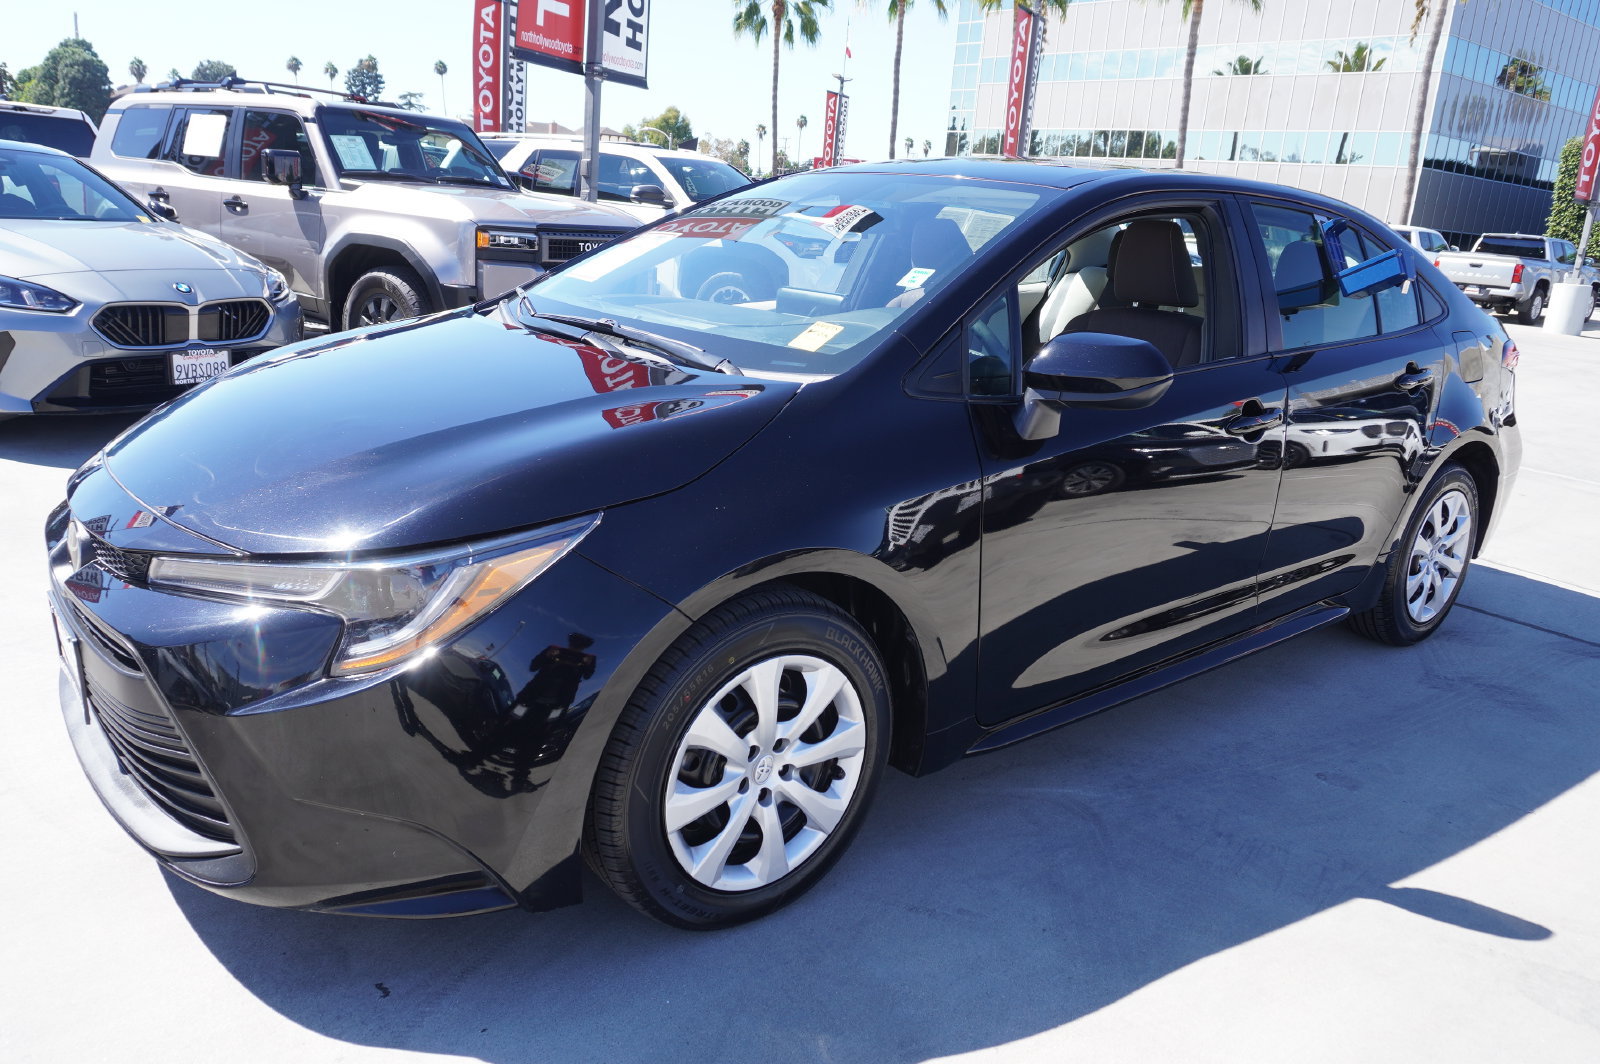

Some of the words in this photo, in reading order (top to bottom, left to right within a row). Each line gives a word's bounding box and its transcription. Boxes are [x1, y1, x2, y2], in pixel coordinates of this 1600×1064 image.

[479, 3, 496, 132] TOYOTA
[1007, 16, 1028, 150] TOYOTA
[175, 361, 227, 379] 9VBS088
[825, 626, 885, 694] BLACKHAWK
